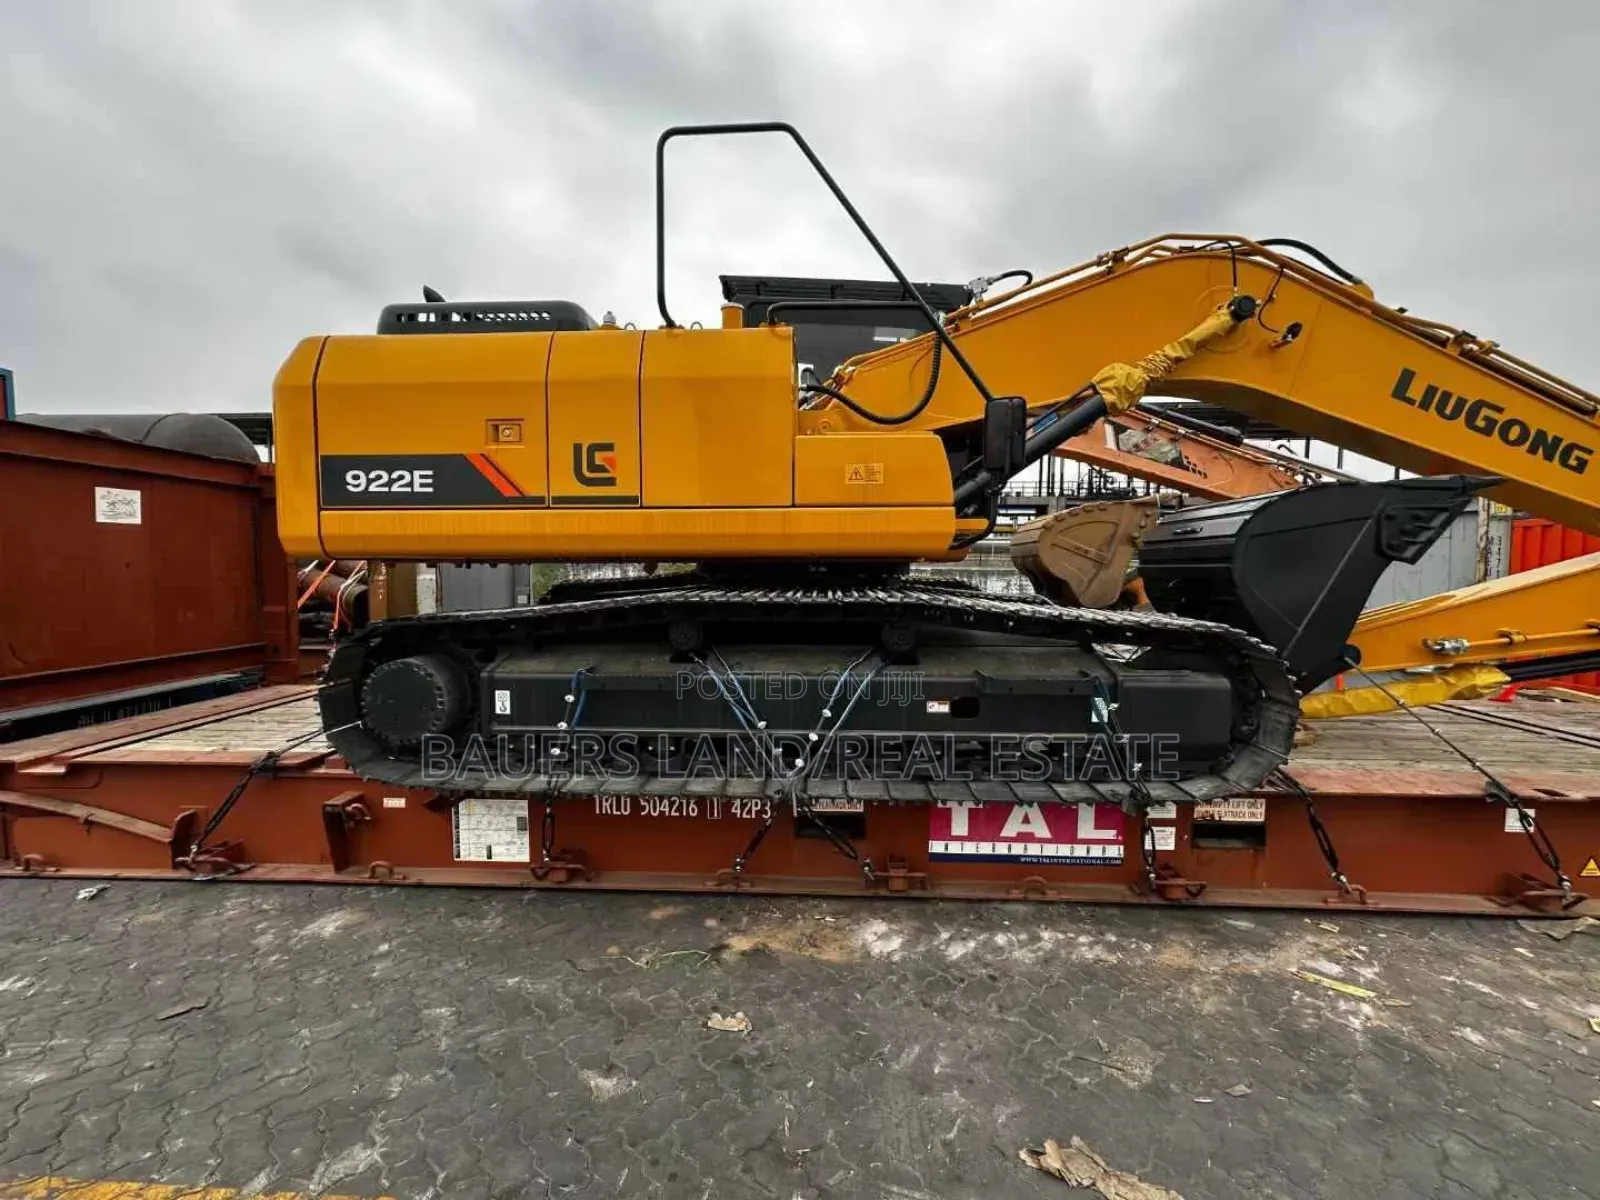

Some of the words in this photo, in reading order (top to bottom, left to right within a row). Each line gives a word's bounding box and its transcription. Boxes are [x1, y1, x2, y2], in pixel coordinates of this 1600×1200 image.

[345, 469, 434, 492] 922E
[639, 796, 698, 816] 504216
[730, 798, 772, 819] 42P3
[937, 800, 1119, 840] TAL
